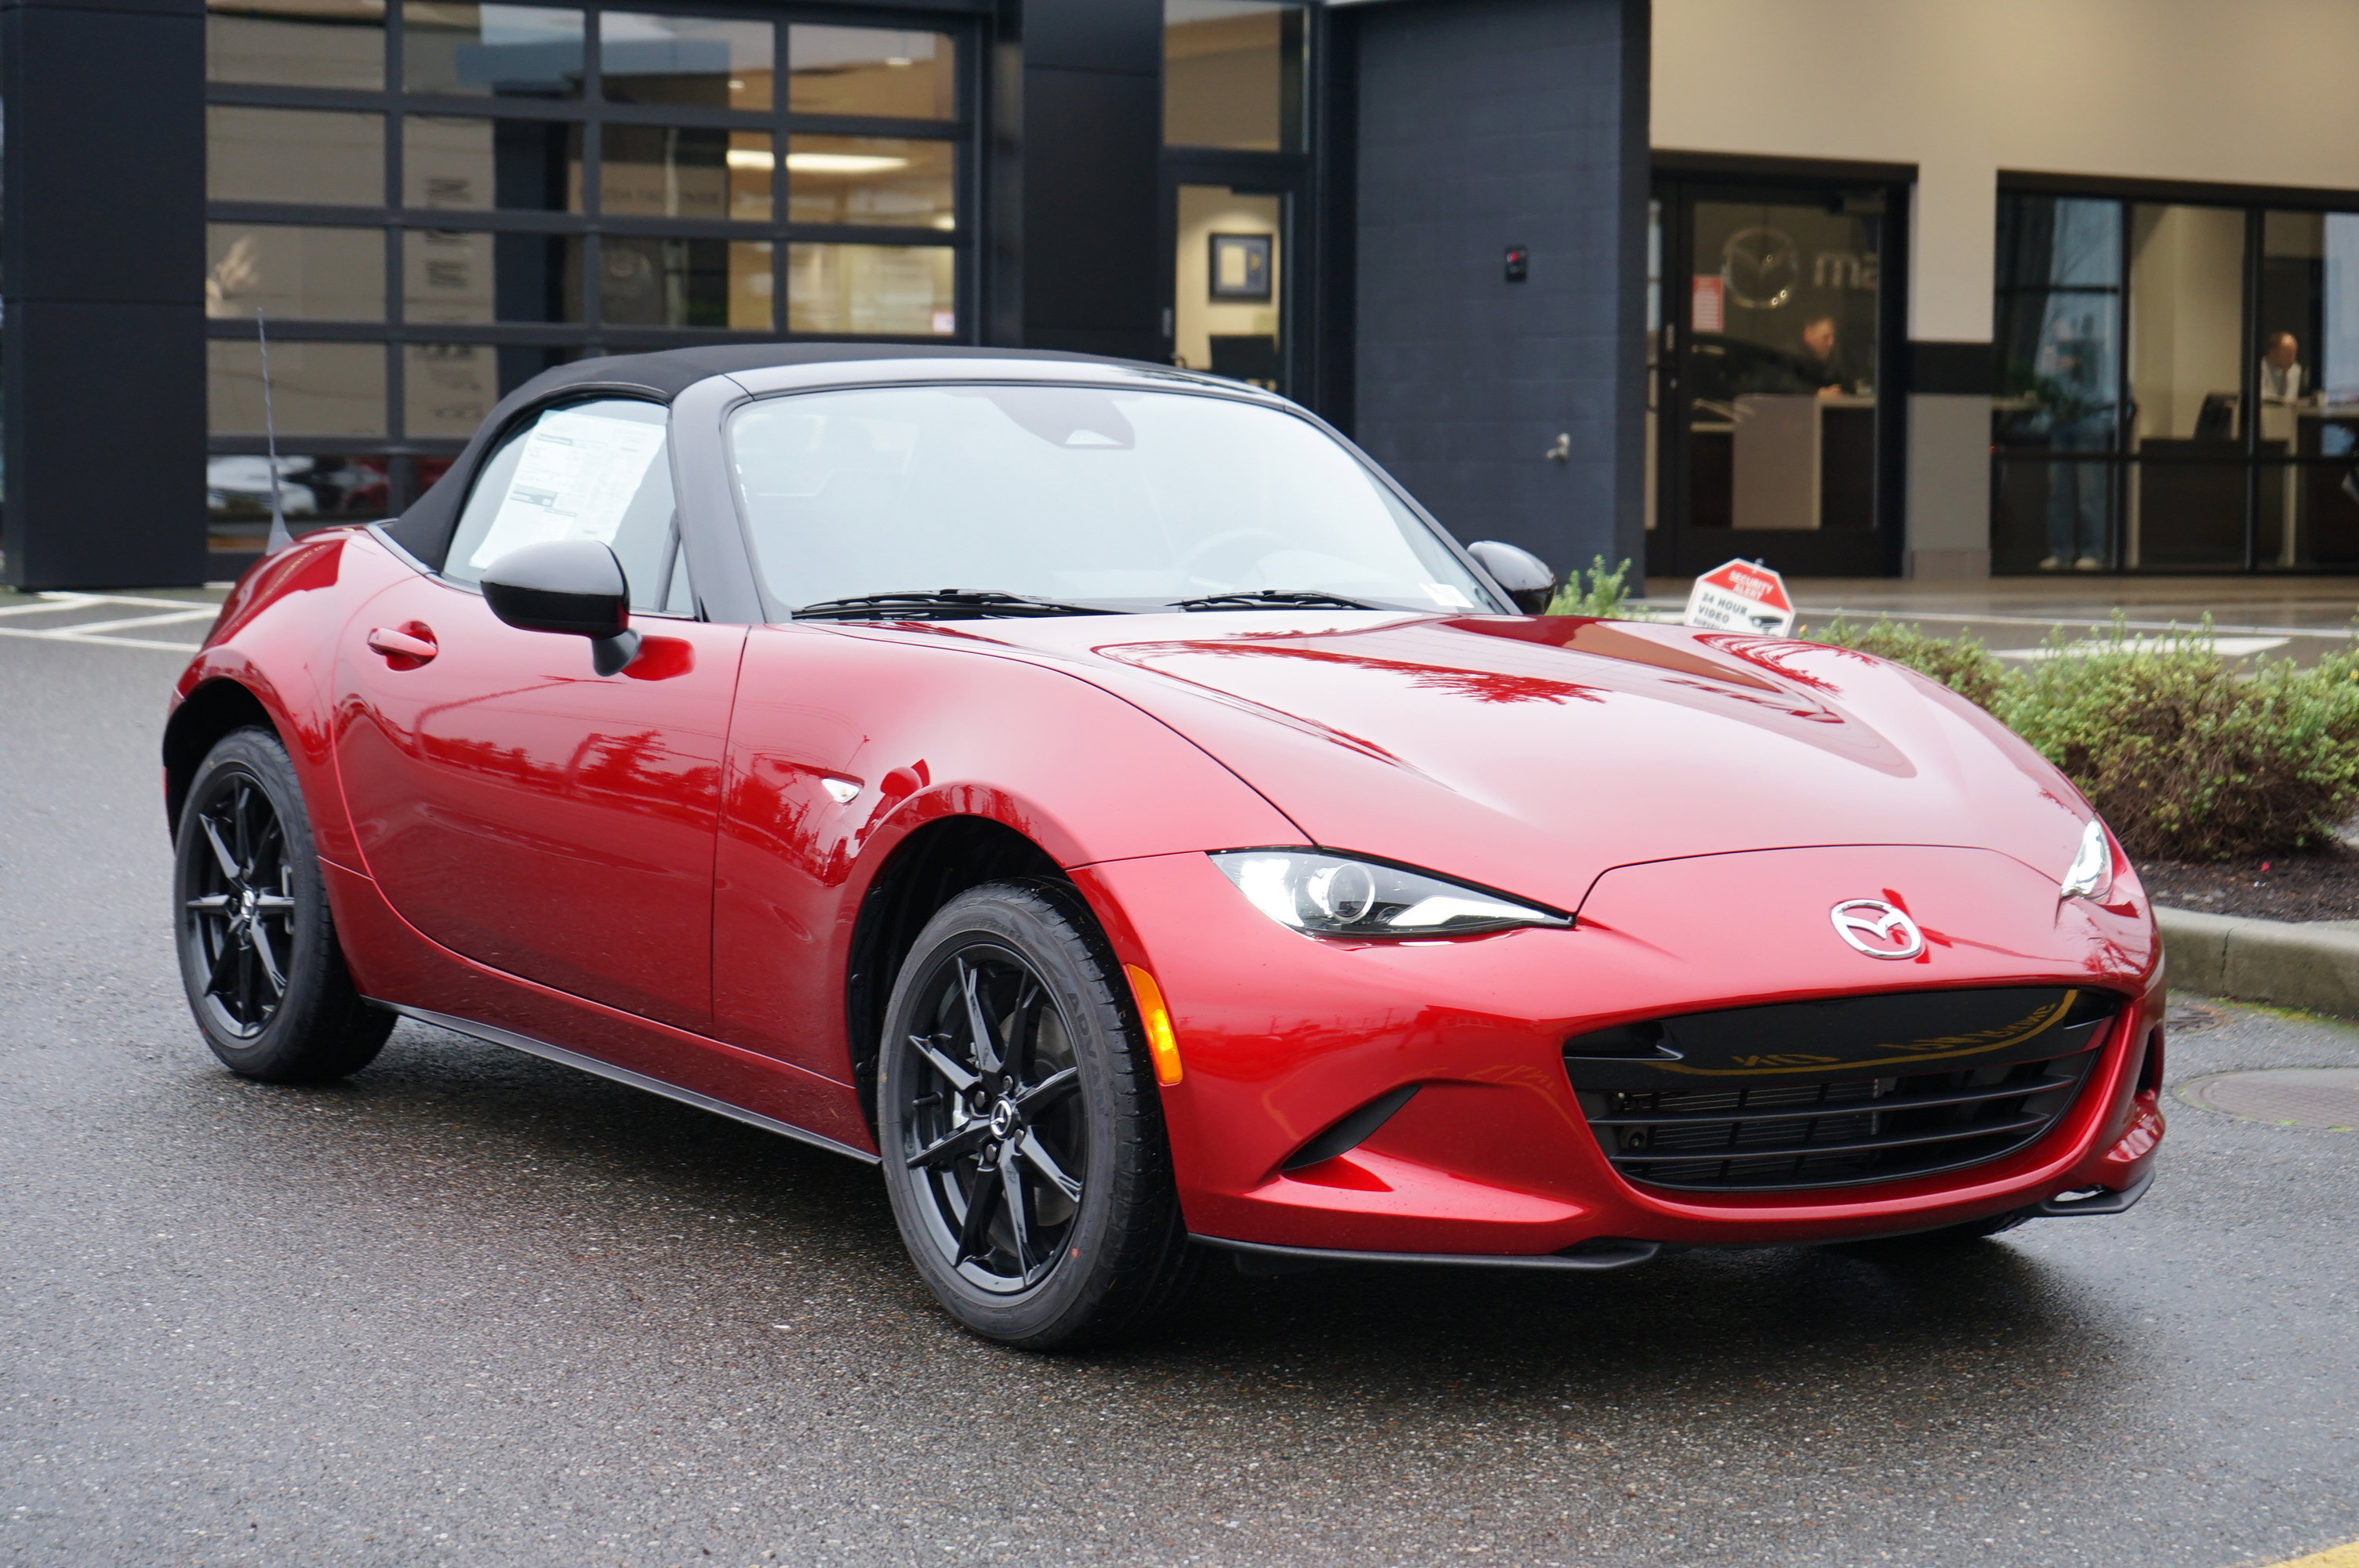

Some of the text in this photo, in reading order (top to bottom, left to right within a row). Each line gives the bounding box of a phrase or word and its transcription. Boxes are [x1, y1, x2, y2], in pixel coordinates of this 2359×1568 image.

[1728, 570, 1775, 595] SECURITY
[1732, 583, 1764, 601] ALERT
[1698, 604, 1731, 624] VIDEO
[1701, 592, 1748, 616] 24 HOUR
